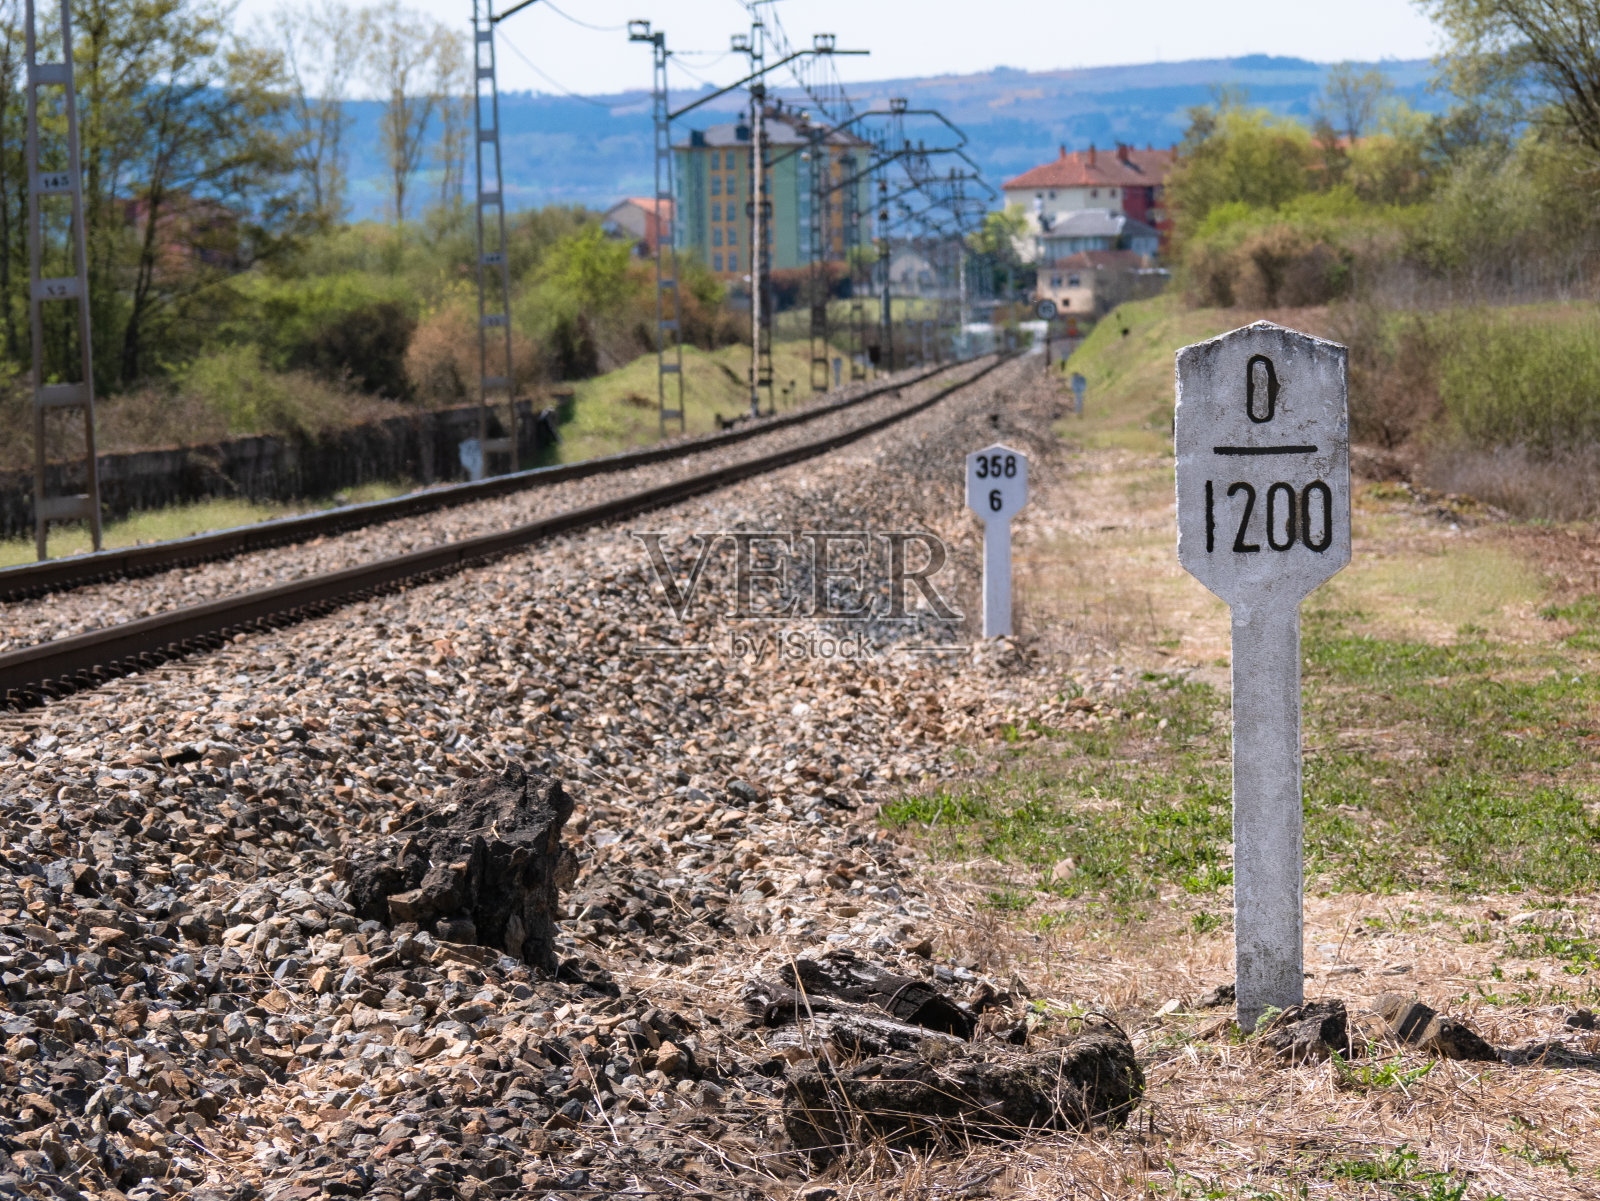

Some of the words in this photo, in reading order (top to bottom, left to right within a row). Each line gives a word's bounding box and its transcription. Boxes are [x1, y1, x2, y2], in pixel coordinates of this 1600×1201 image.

[1246, 353, 1281, 424] 0
[976, 455, 1016, 478] 358
[989, 489, 1002, 512] 6
[1205, 479, 1332, 553] 1200
